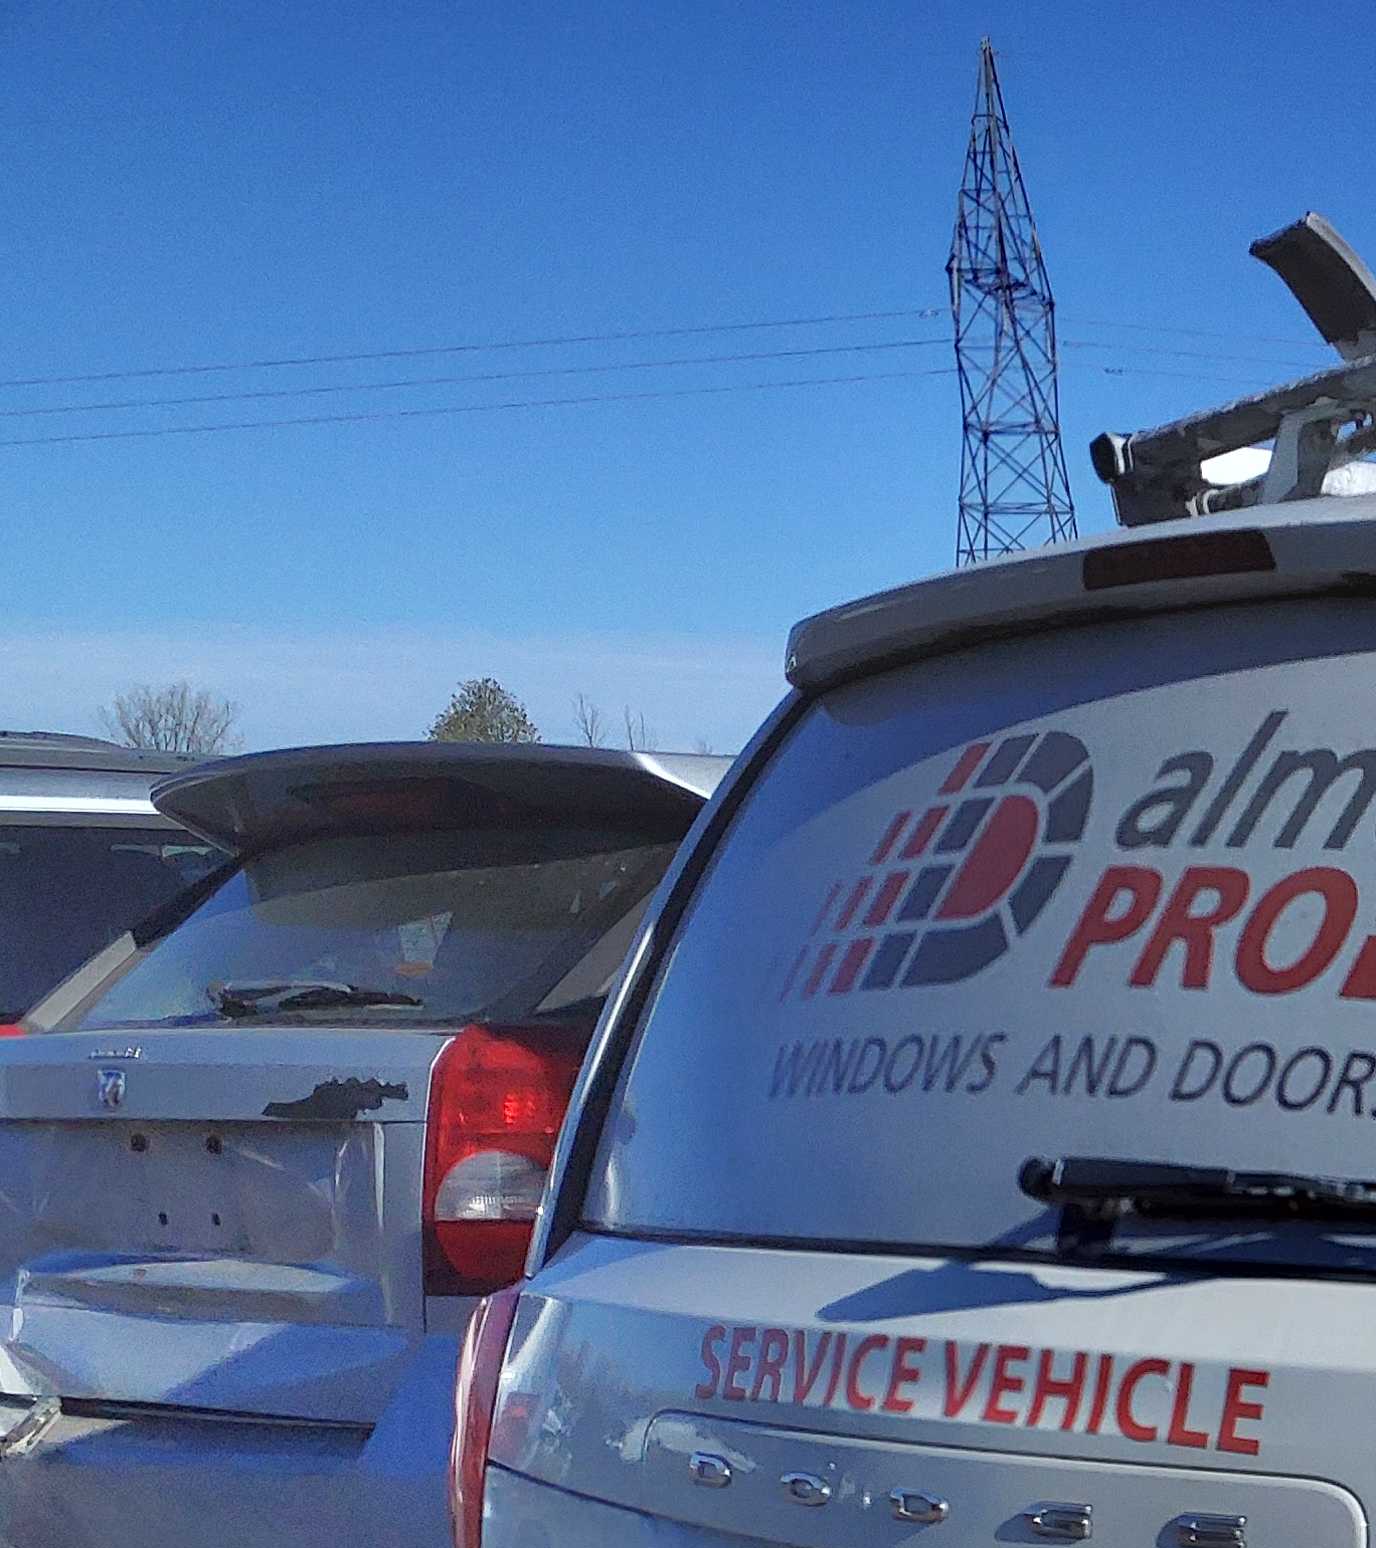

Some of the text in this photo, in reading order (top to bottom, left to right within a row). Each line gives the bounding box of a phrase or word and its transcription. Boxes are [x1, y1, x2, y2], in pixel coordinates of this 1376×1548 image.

[1050, 866, 1359, 995] PRO
[770, 1033, 1006, 1099] WINDOWS
[1017, 1034, 1156, 1099] AND
[694, 1324, 1271, 1456] SERVICE VEHICLE
